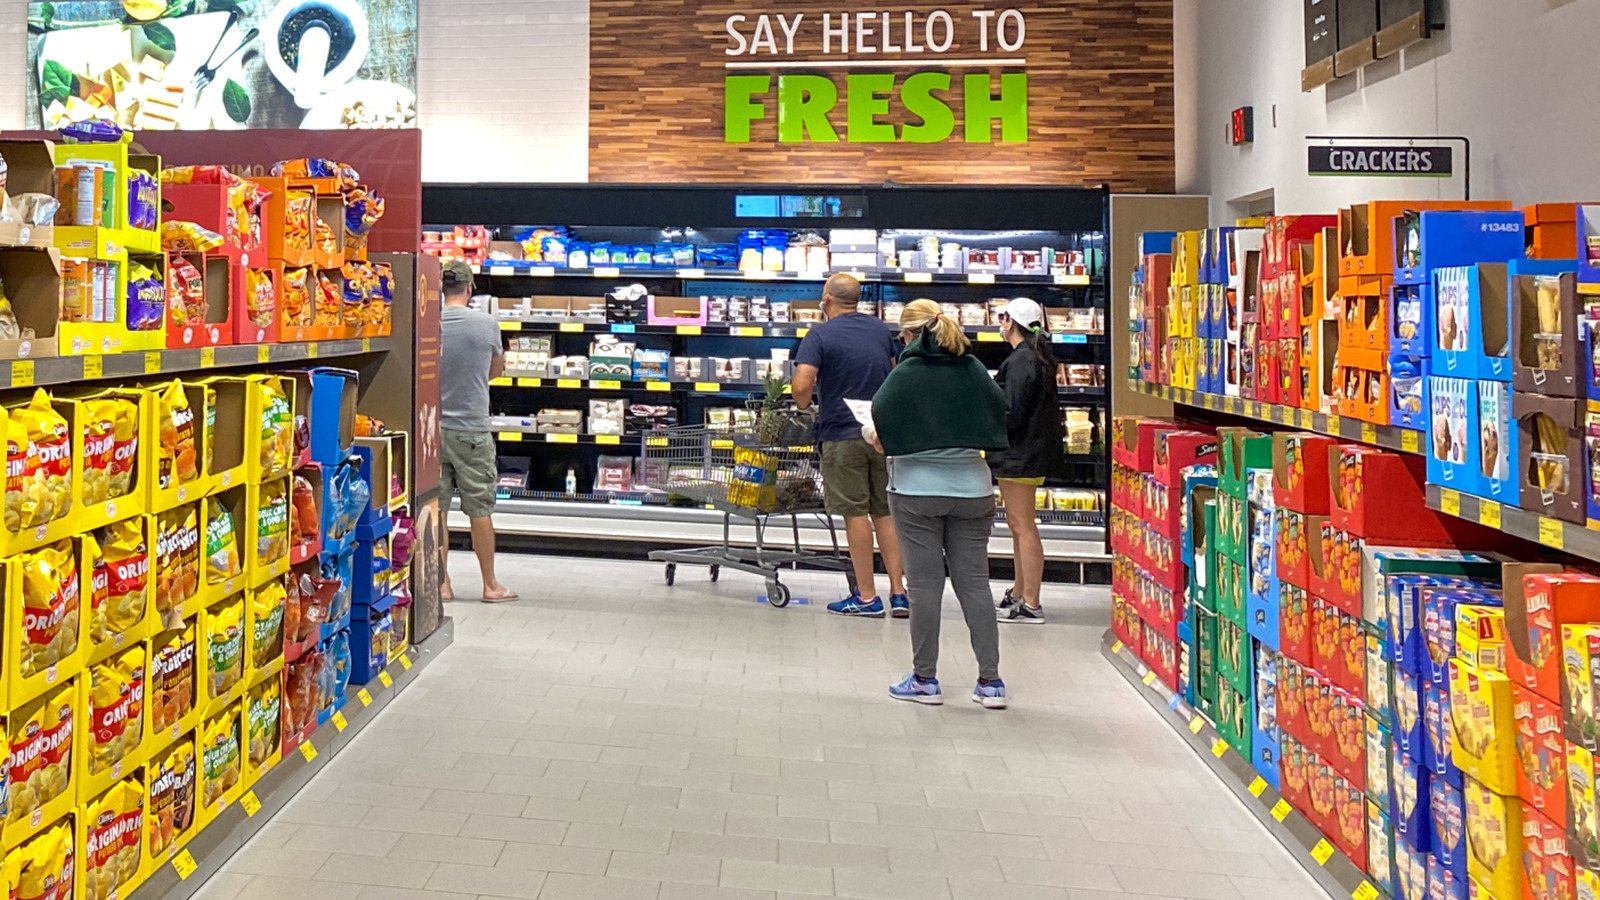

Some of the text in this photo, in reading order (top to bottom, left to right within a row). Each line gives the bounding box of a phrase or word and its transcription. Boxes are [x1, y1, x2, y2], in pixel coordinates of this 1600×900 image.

[725, 9, 1026, 55] SAY HELLO TO
[725, 72, 1028, 143] FRESH
[1329, 150, 1433, 172] CRACKERS
[1481, 223, 1519, 232] #13483
